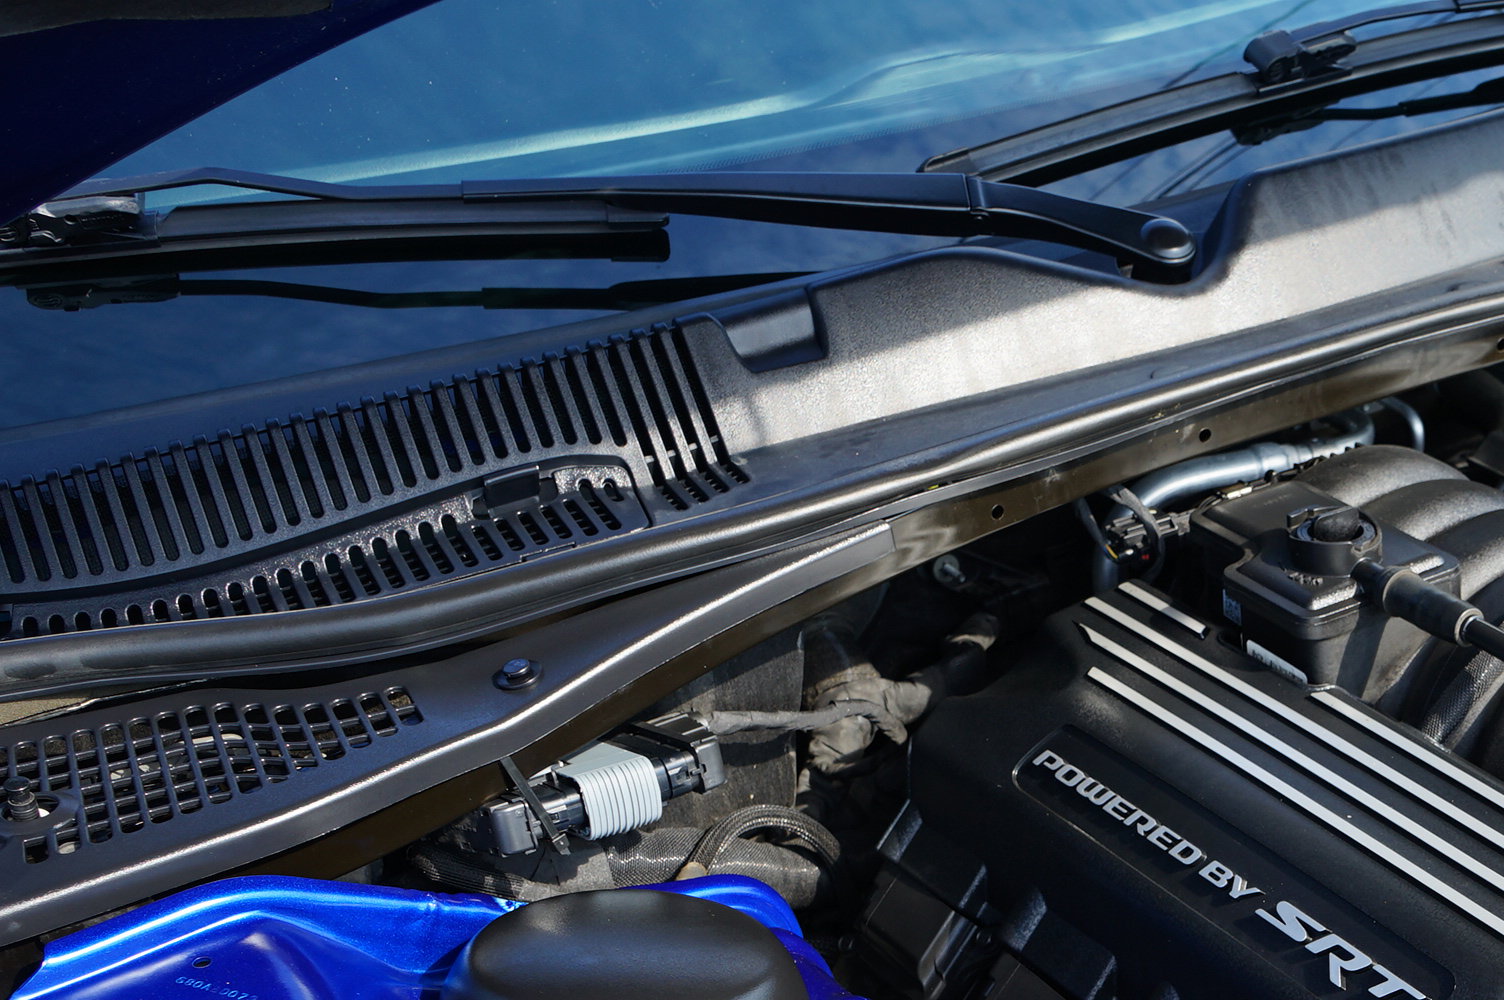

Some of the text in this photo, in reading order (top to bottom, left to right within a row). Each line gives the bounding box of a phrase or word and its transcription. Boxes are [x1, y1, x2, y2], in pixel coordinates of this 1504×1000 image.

[1032, 749, 1428, 1000] POWERED BY SRT
